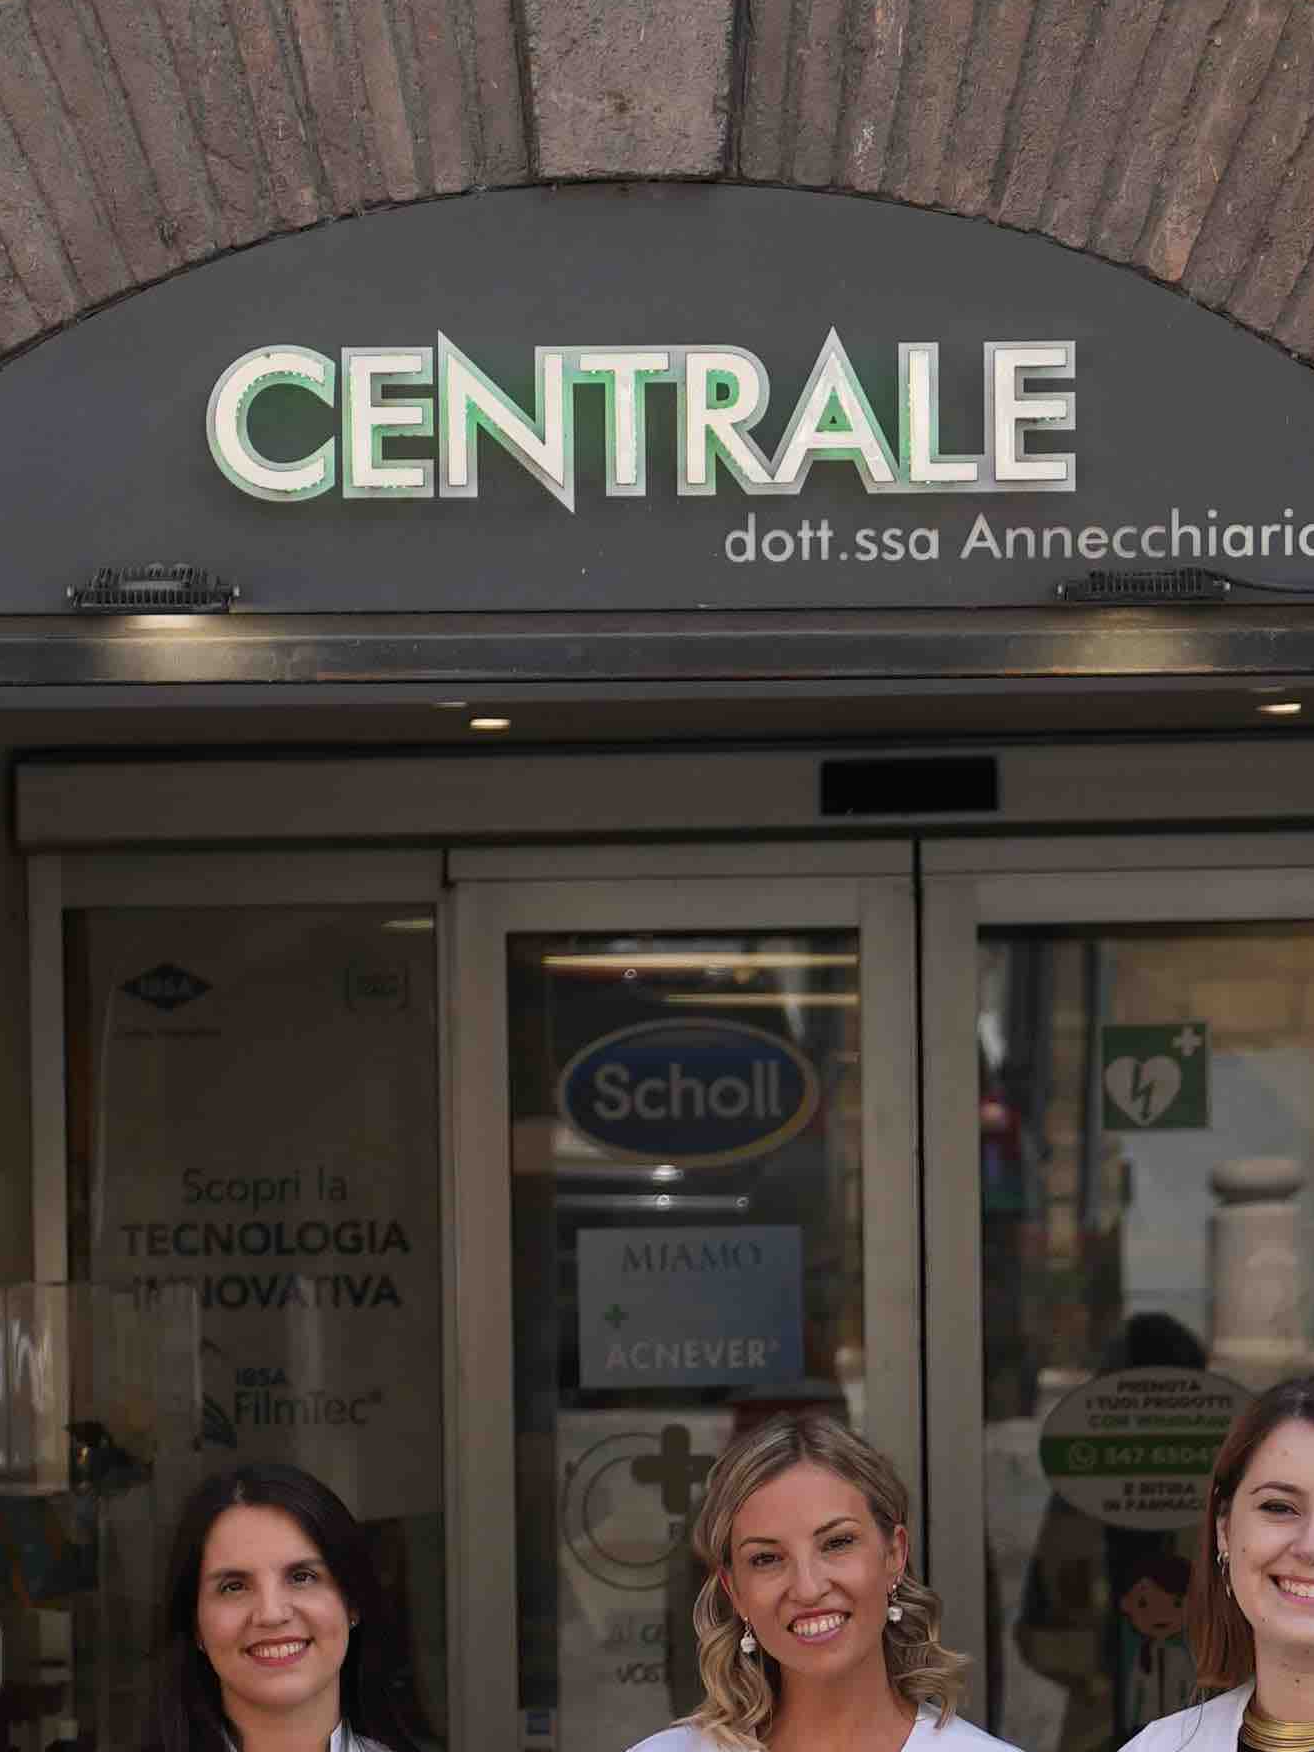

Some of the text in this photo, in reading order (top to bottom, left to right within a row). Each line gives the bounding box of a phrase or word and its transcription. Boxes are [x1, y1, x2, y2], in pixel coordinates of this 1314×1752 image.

[206, 327, 1076, 513] CENTRALE
[724, 512, 941, 564] dott.ssa
[592, 1061, 783, 1122] Scholl
[182, 1165, 349, 1214] Scopri la
[118, 1218, 411, 1257] TECNOLOGIA
[621, 1239, 764, 1274] MIAMO
[604, 1338, 767, 1371] ACNEVER
